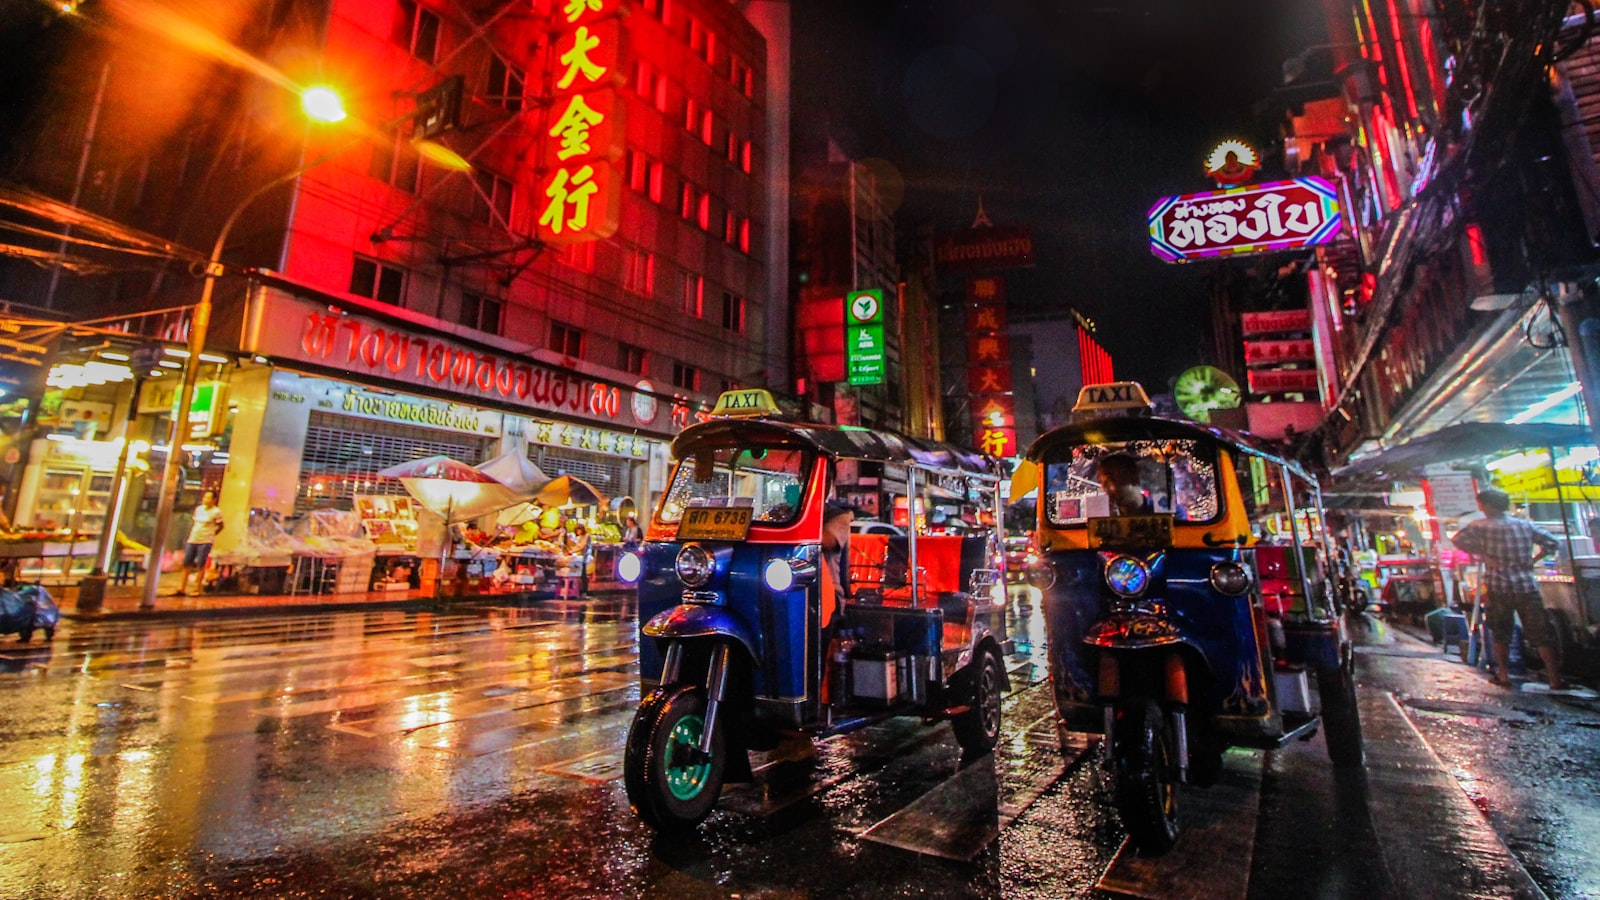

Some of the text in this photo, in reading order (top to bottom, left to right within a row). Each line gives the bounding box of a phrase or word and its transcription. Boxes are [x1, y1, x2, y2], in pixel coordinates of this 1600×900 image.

[1168, 193, 1320, 248] ทองใบ
[724, 393, 758, 408] TAXI
[1088, 386, 1132, 403] TAXI
[714, 511, 747, 525] 6738
